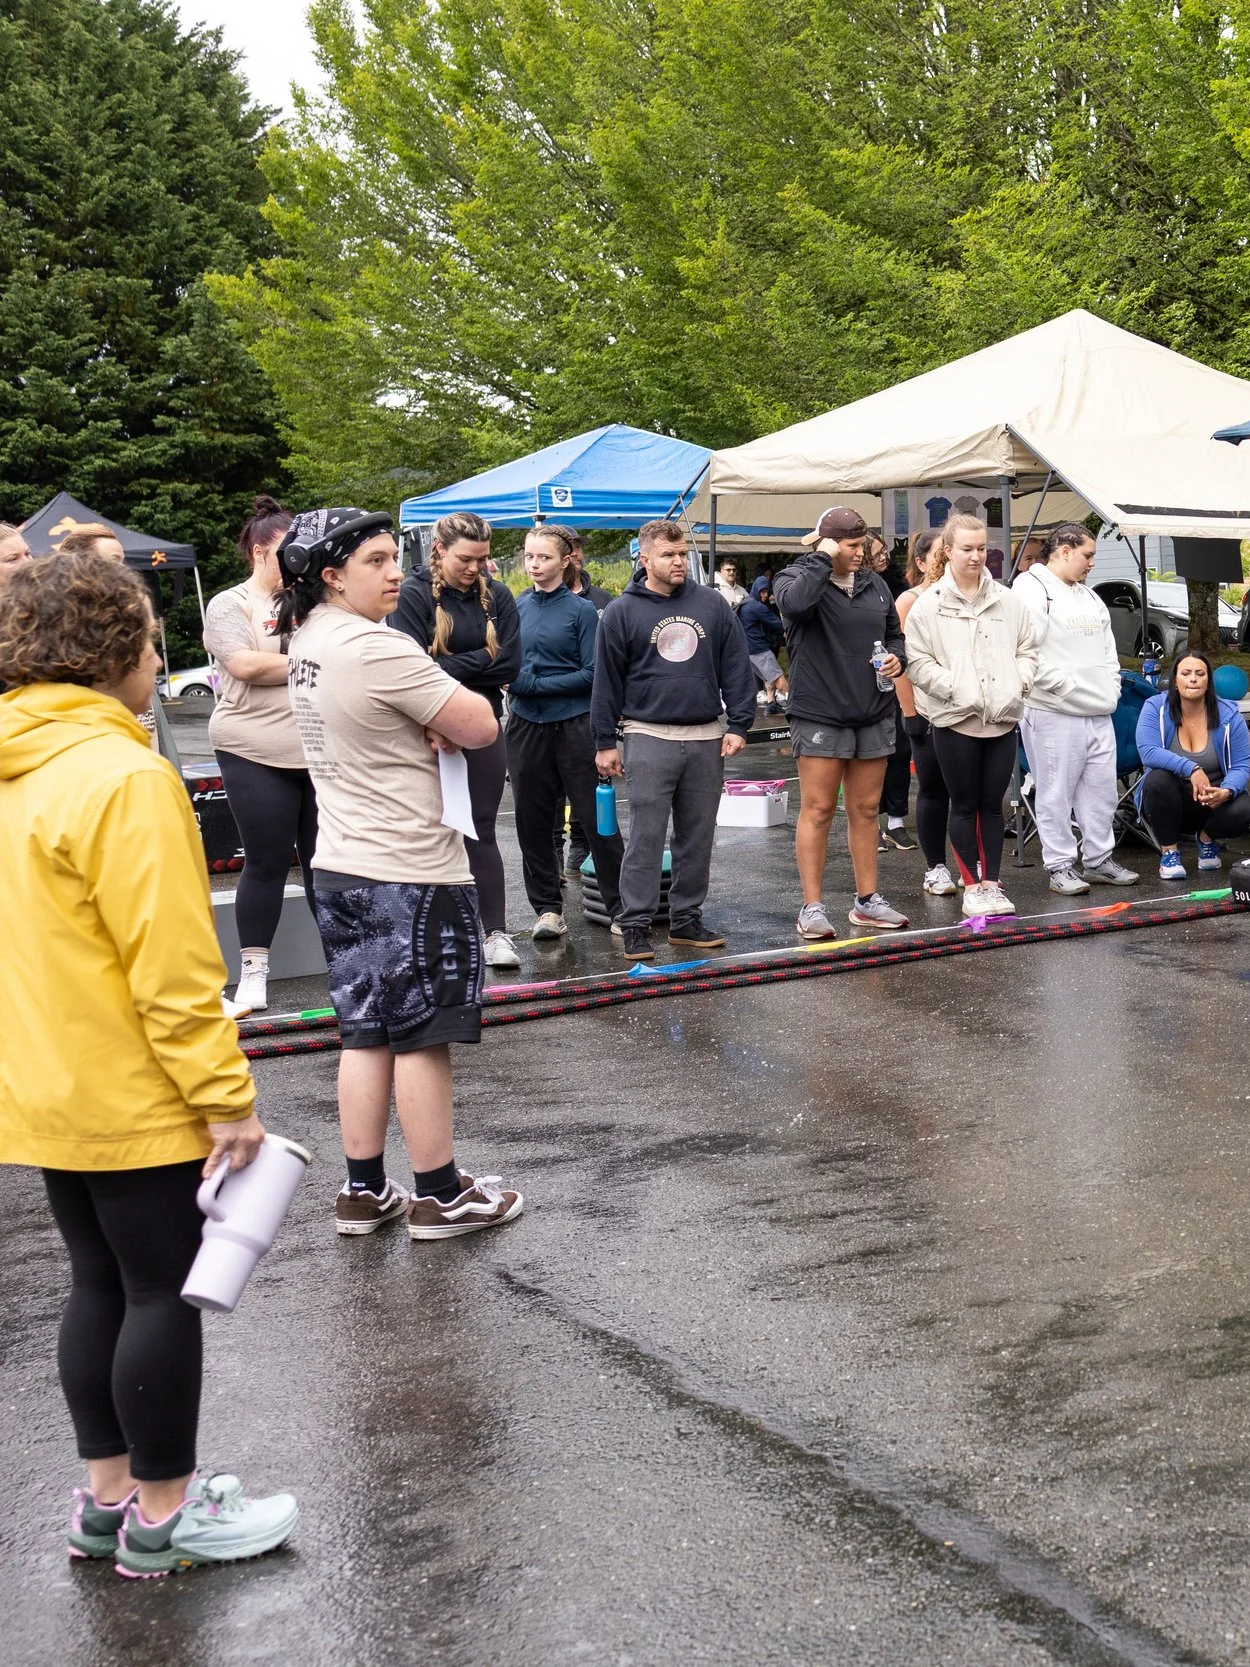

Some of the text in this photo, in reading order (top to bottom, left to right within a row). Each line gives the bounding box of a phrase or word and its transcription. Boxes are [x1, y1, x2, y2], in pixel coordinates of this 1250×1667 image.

[650, 615, 706, 644] UNITED STATES MARINE CORPS
